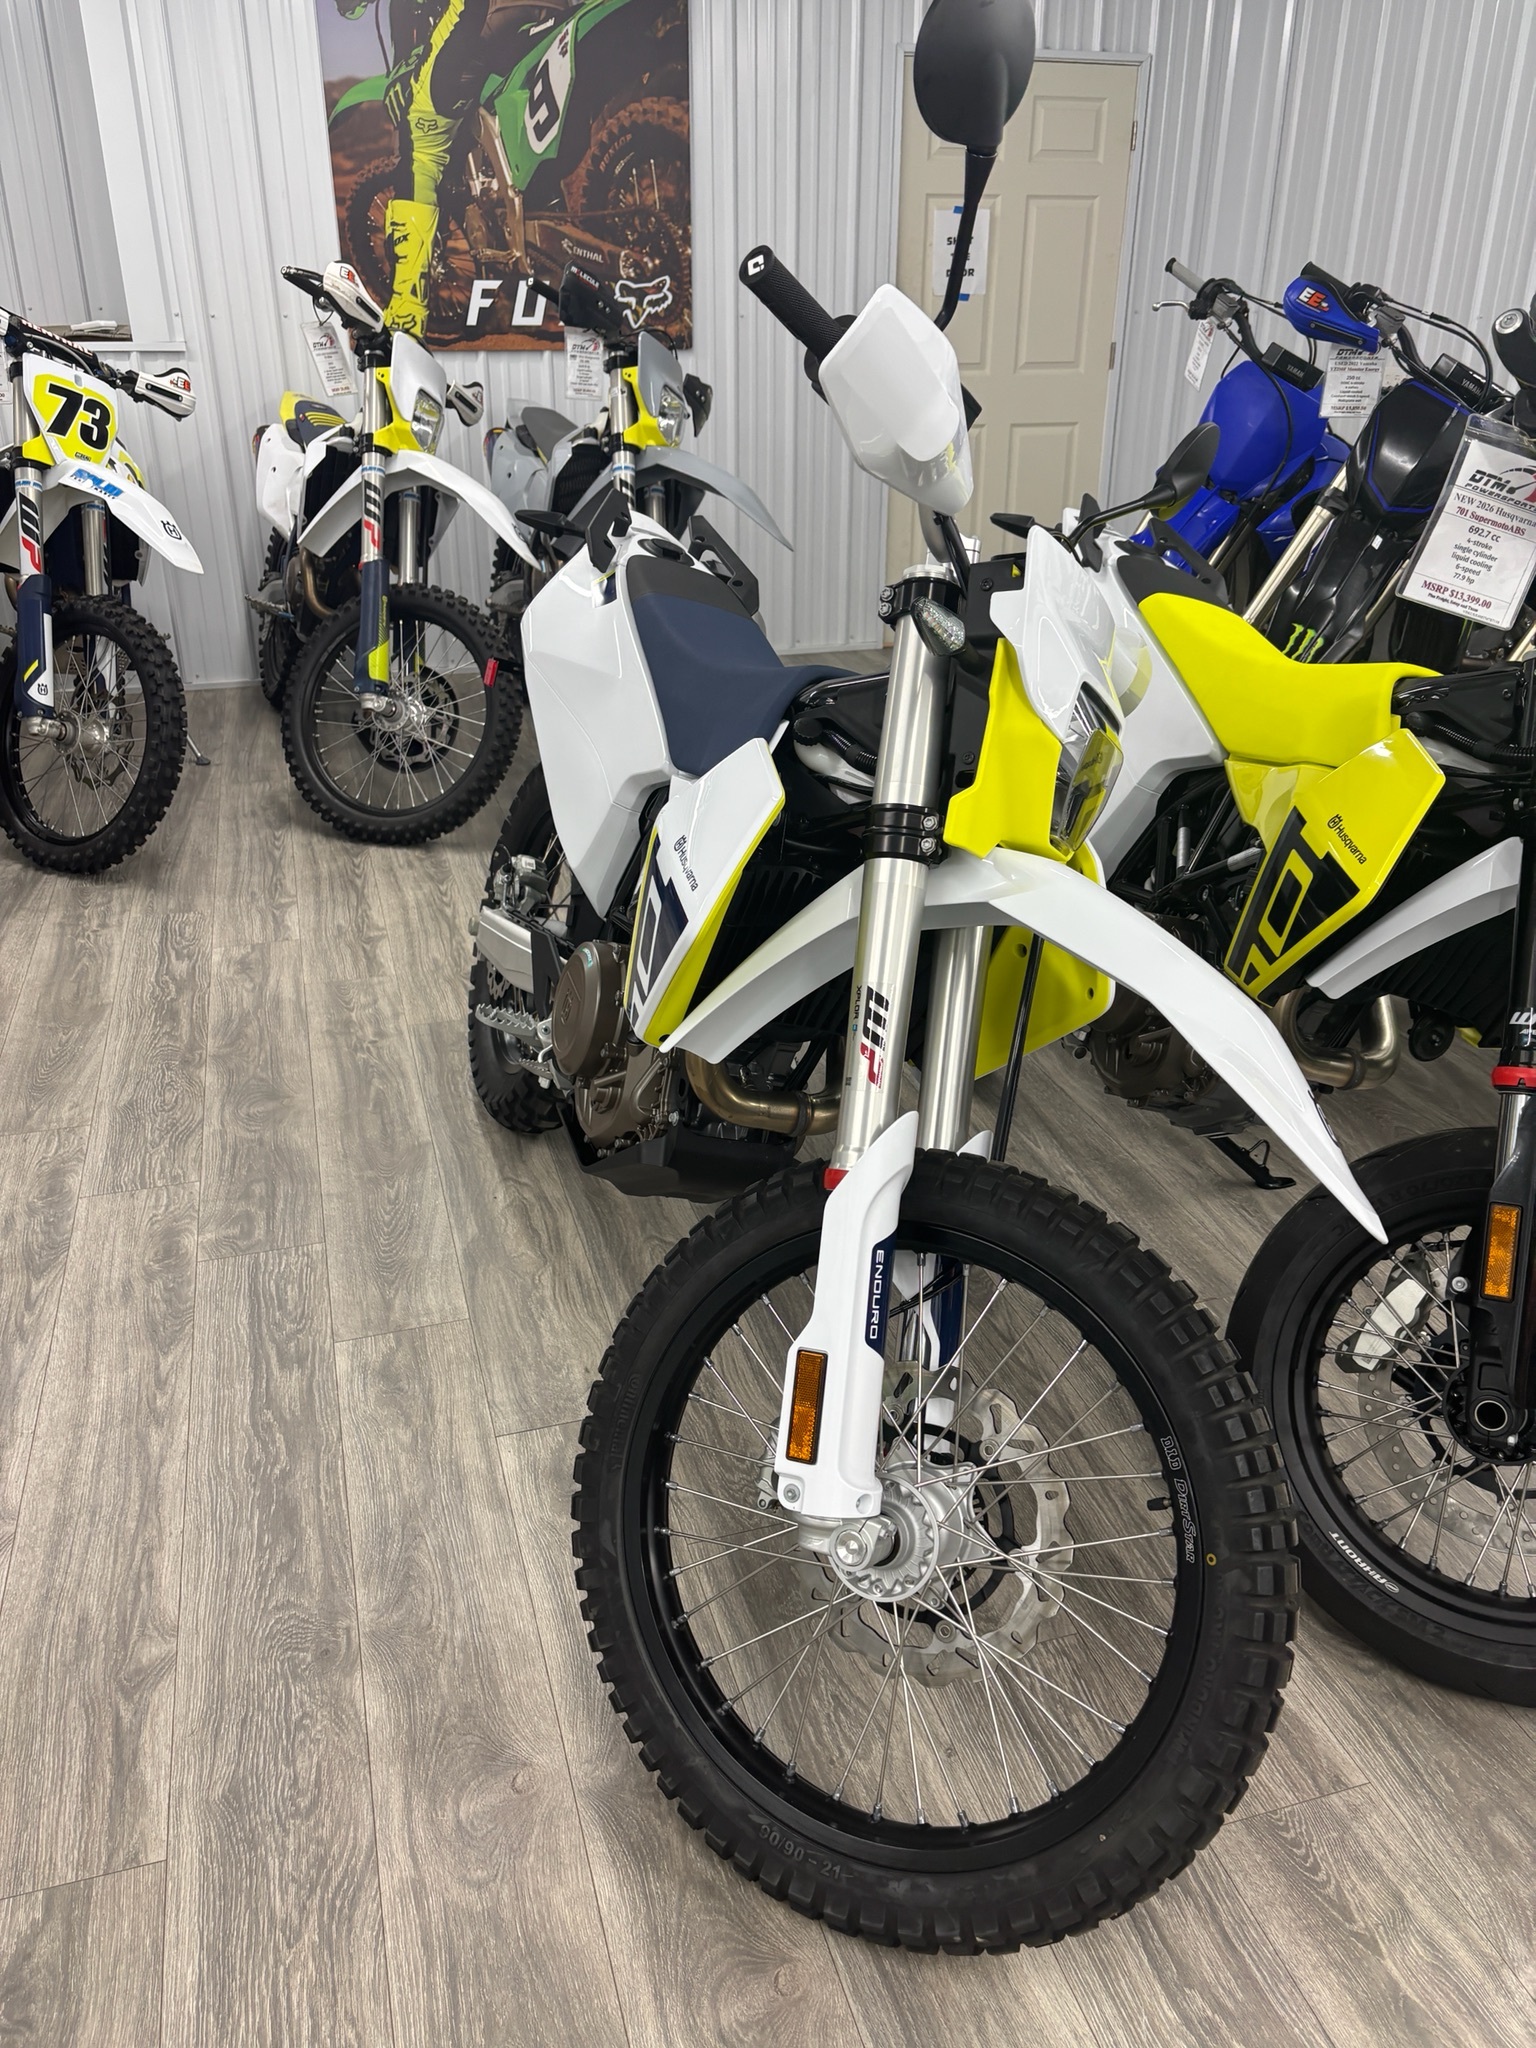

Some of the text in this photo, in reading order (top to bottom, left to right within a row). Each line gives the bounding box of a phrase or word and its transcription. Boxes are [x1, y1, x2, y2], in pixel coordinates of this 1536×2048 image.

[466, 279, 566, 327] FO
[47, 383, 111, 450] 73
[1468, 469, 1509, 493] DTM
[1455, 493, 1476, 506] NEW
[1476, 500, 1495, 513] 2026
[1456, 506, 1527, 536] 701 SupermotoABS
[1468, 525, 1491, 538] 692.7
[1453, 543, 1498, 562] single cylinder
[1467, 538, 1493, 551] 4-stroke
[1451, 551, 1493, 572] liquid cooling
[1455, 563, 1481, 576] 6-speed
[1453, 572, 1475, 586] 77.9 hp
[1421, 580, 1492, 609] MSRP $13,399.00
[1333, 819, 1367, 865] Husqvarna
[676, 846, 699, 892] Husqvarna
[854, 985, 862, 1020] XPLOR
[869, 1249, 885, 1339] ENDURO
[759, 1824, 805, 1862] 90/90
[820, 1860, 841, 1879] 21
